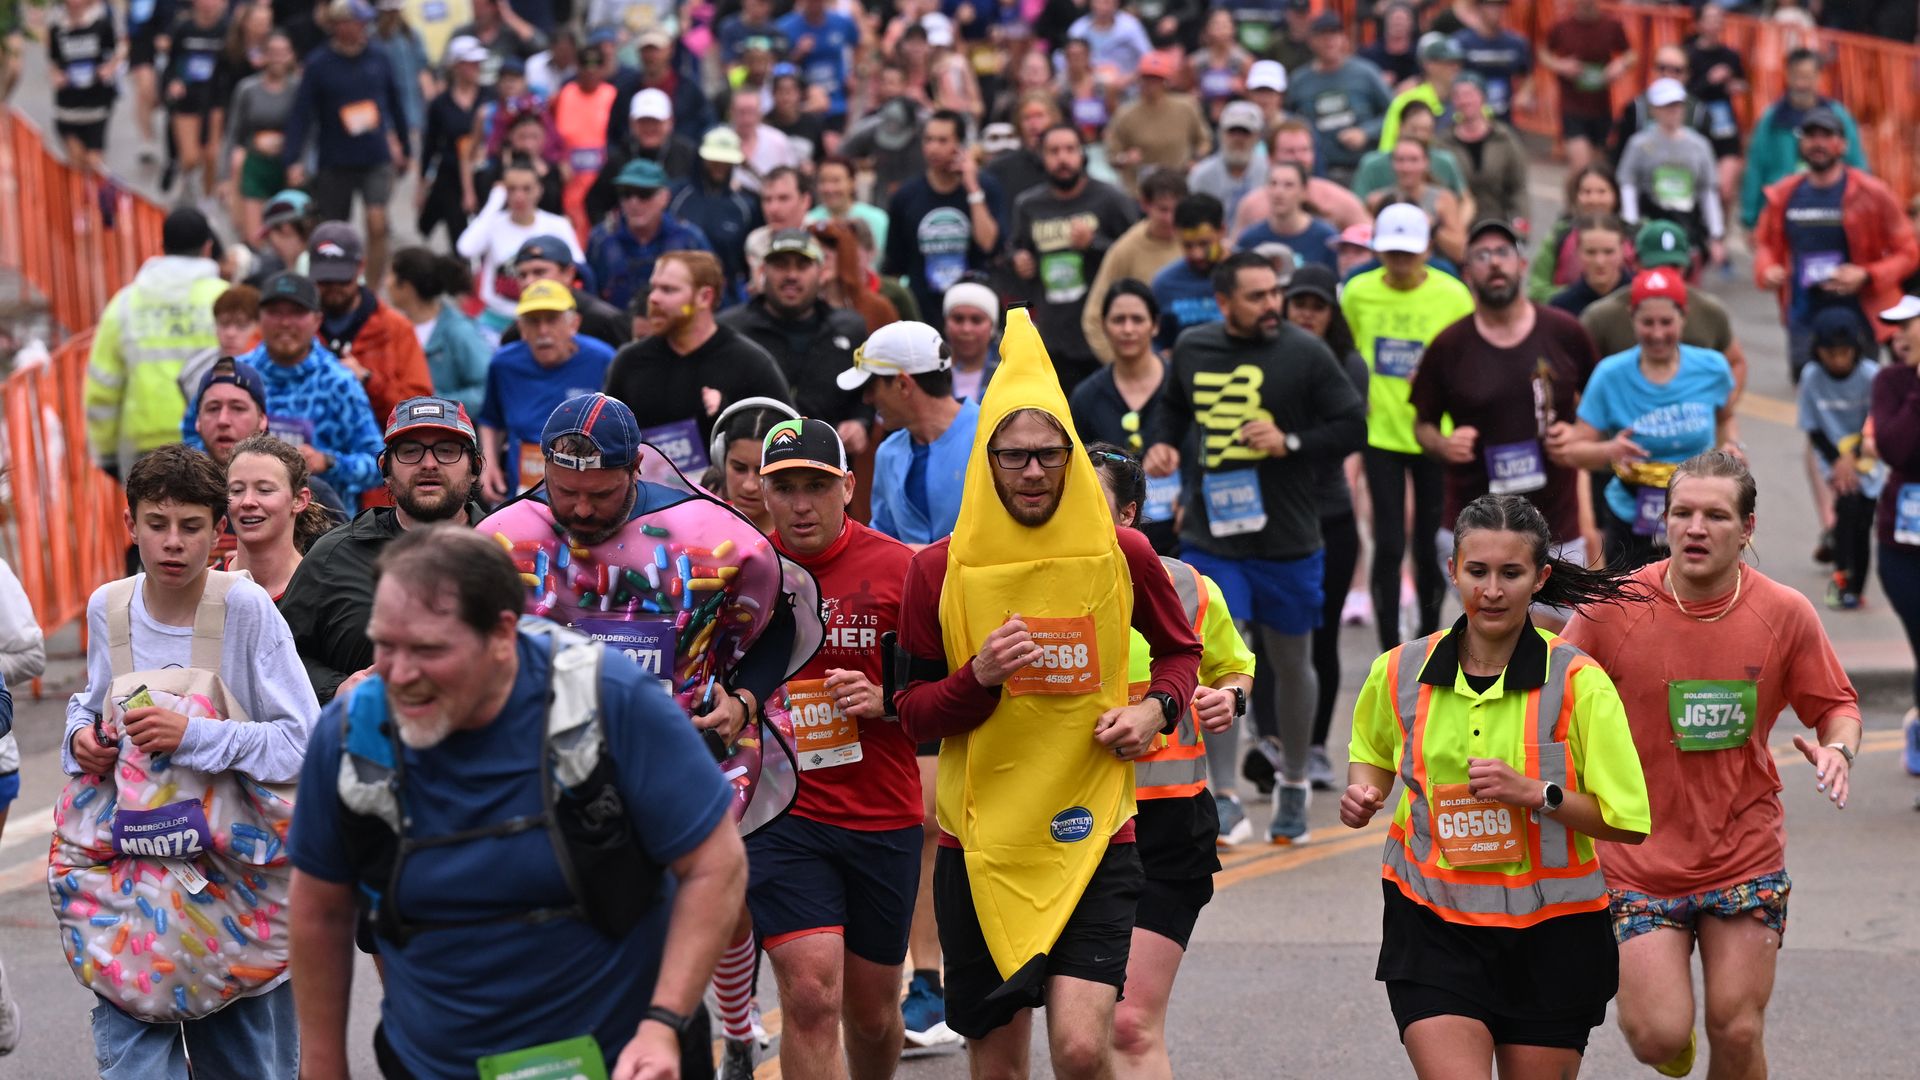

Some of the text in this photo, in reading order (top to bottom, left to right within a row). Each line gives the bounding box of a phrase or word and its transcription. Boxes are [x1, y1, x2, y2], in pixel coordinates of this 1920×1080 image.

[836, 615, 878, 625] 2.7.15
[592, 634, 659, 643] BOLDERBOULDER
[824, 628, 877, 648] HER
[623, 648, 662, 675] 071
[1031, 643, 1088, 670] 568
[792, 703, 848, 728] A094
[1678, 704, 1746, 727] JG374
[124, 816, 188, 832] BOLDERBOULDER
[1438, 808, 1512, 839] GG569
[1471, 842, 1484, 852] 45
